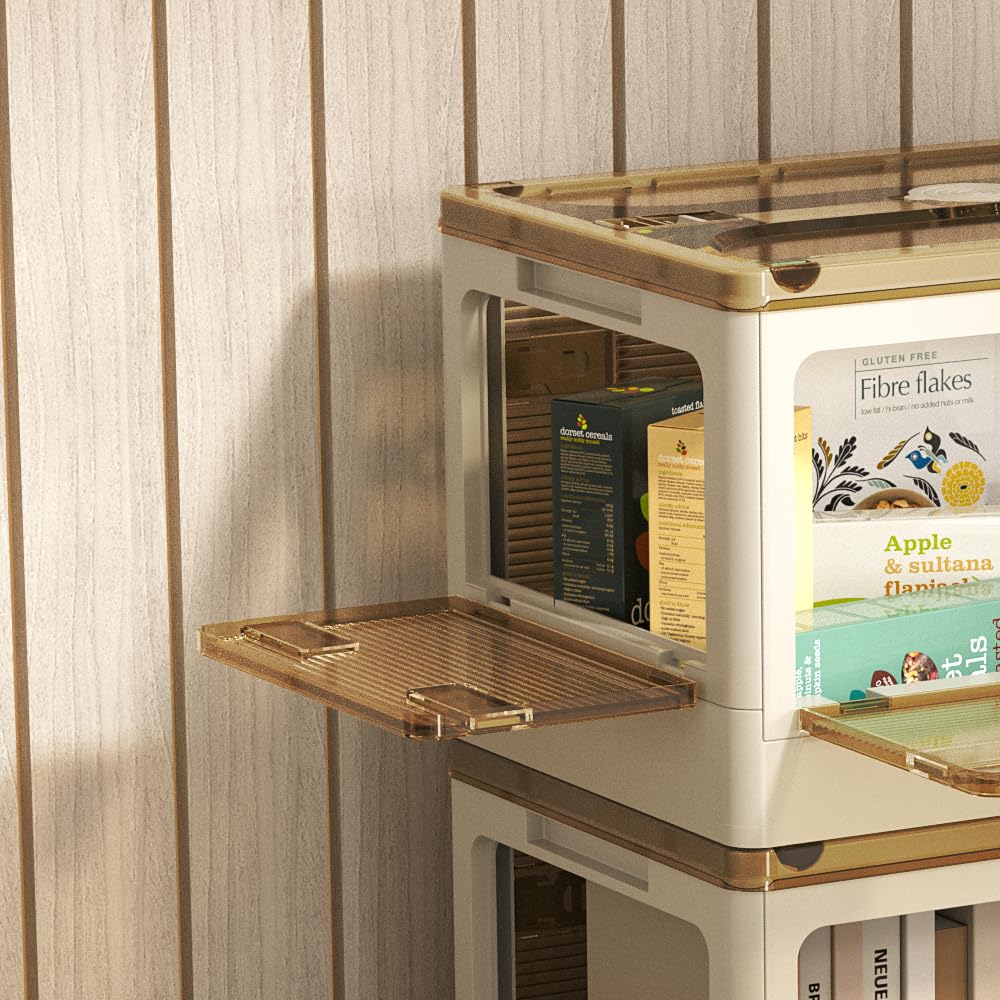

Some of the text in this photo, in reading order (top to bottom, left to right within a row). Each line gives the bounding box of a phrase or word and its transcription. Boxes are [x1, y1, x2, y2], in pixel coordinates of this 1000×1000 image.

[862, 351, 937, 366] GLUTEN FREE
[861, 368, 972, 400] Fibre flakes
[671, 402, 694, 415] toasted
[920, 401, 940, 409] added
[940, 399, 953, 407] nuts
[560, 426, 613, 441] dorset cereals
[884, 534, 953, 555] Apple
[884, 556, 994, 575] & sultana
[813, 639, 821, 667] seeds
[941, 653, 962, 679] et
